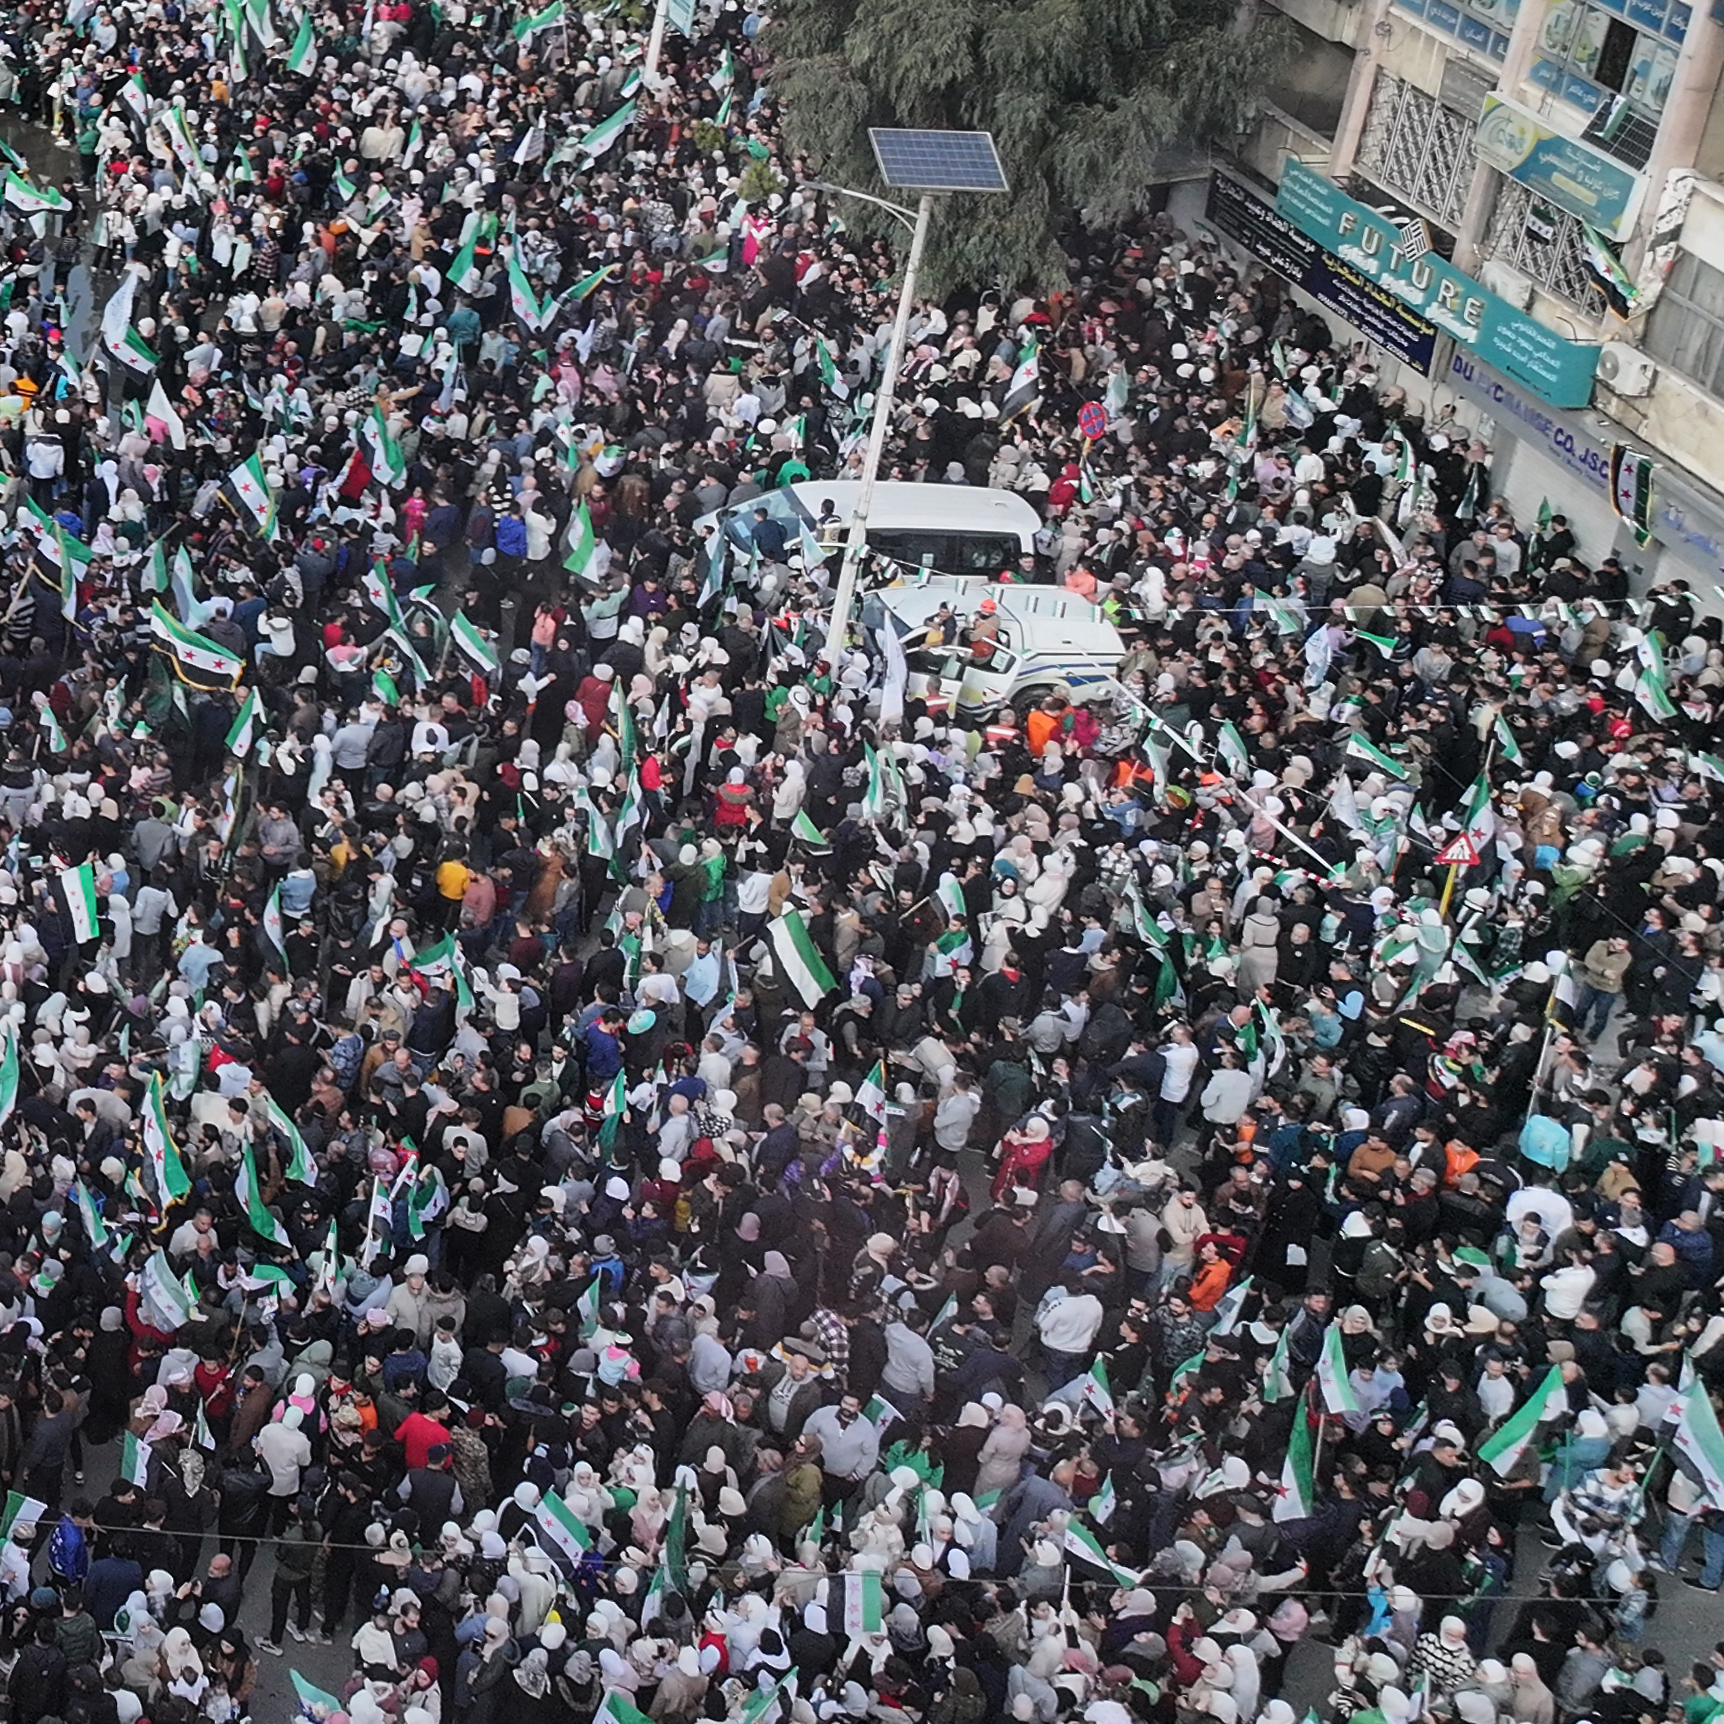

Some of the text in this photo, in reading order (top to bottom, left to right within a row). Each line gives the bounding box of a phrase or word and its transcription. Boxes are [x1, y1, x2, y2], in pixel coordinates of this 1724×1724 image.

[1339, 211, 1484, 326] FUTURE
[1453, 354, 1474, 381] DU
[1579, 447, 1610, 480] JSC
